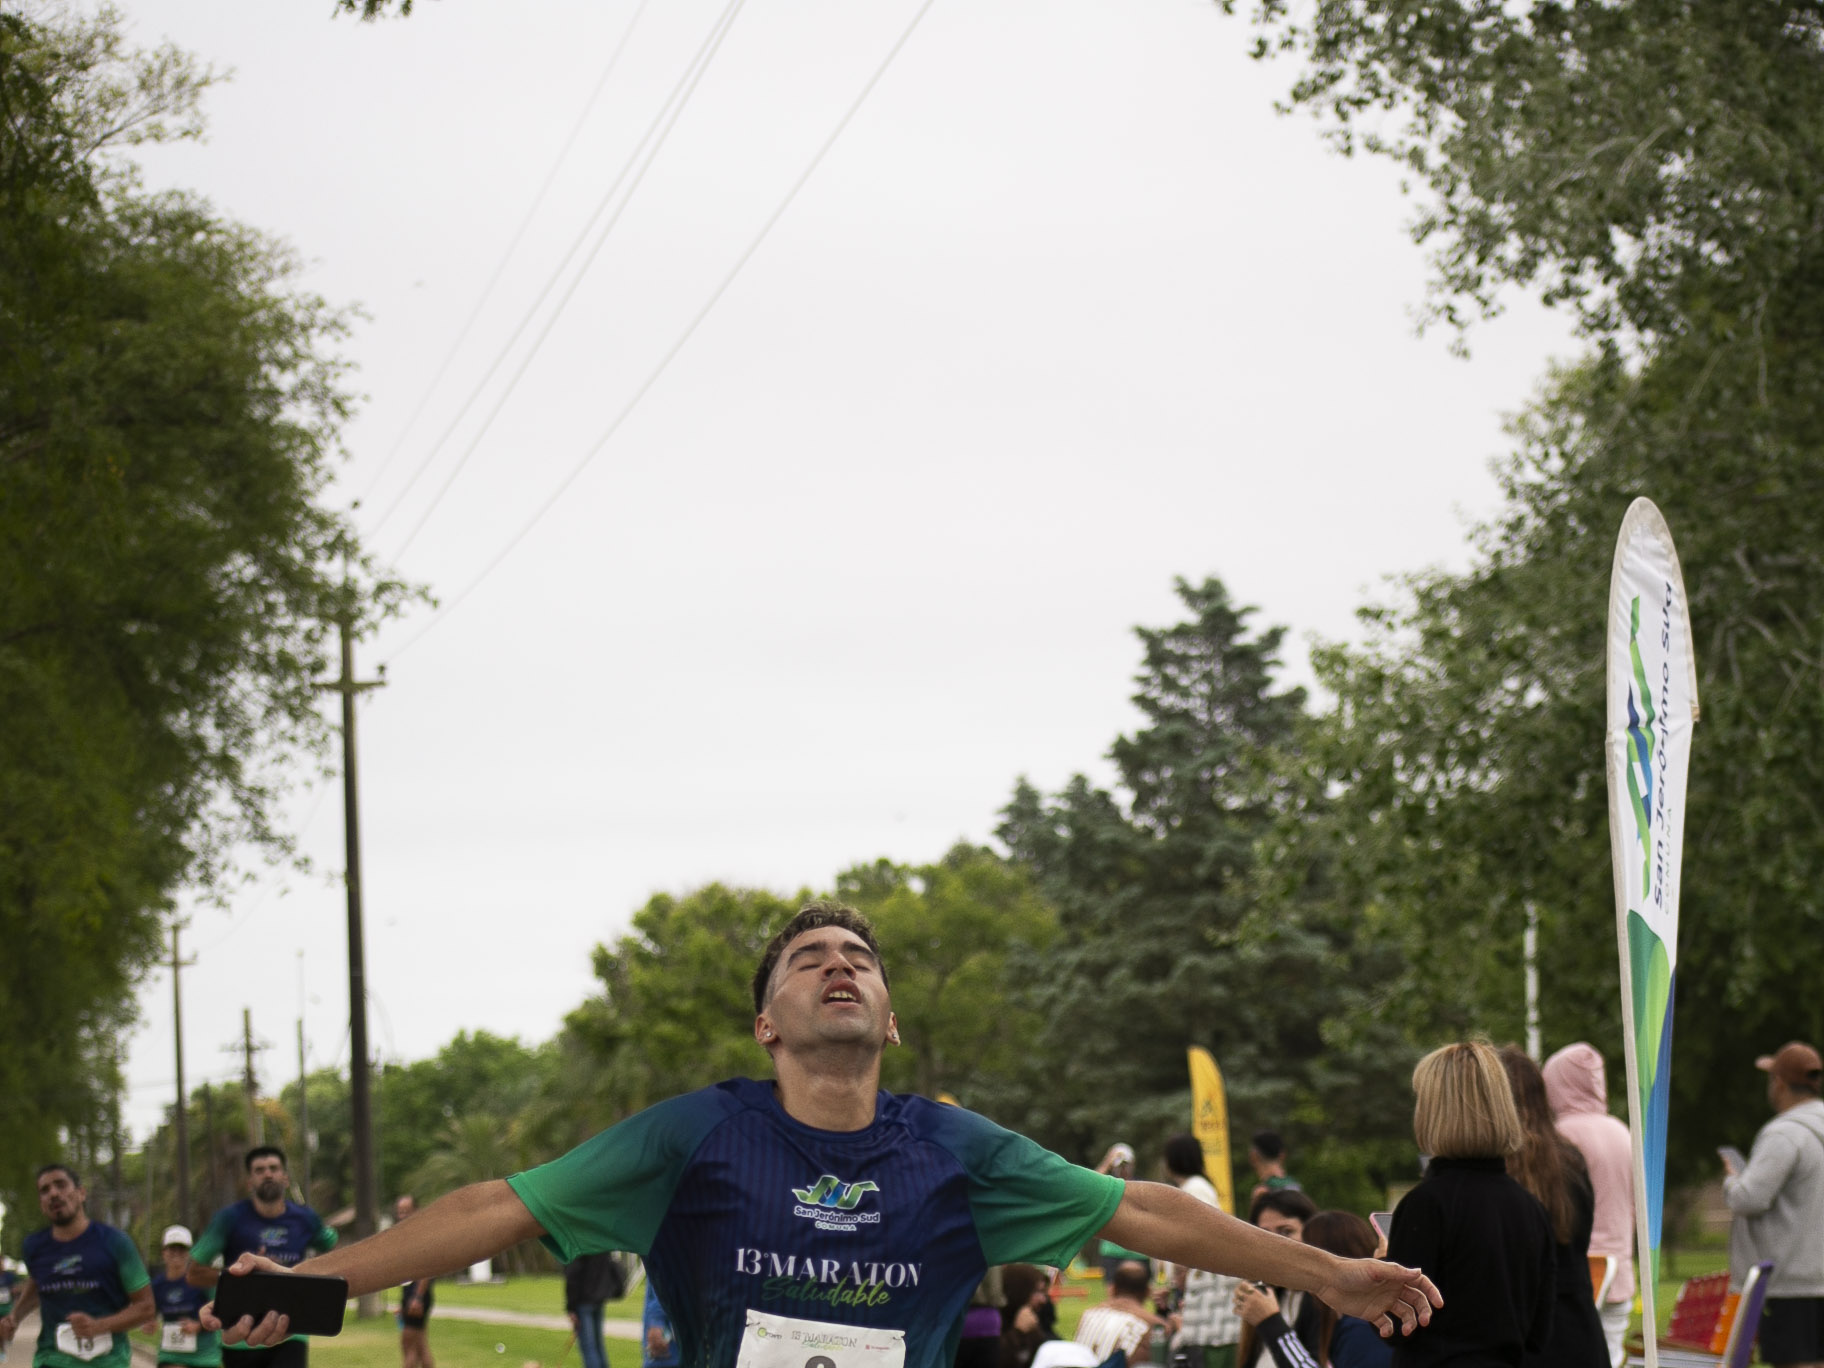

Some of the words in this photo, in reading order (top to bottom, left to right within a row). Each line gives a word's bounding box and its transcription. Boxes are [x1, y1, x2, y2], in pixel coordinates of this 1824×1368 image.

[1654, 839, 1664, 911] San
[1661, 580, 1672, 654] Sud
[1664, 807, 1672, 915] COMUNA
[794, 1206, 814, 1218] San
[860, 1212, 880, 1223] Sud
[815, 1222, 857, 1231] COMUNA
[761, 1275, 891, 1307] Saludable
